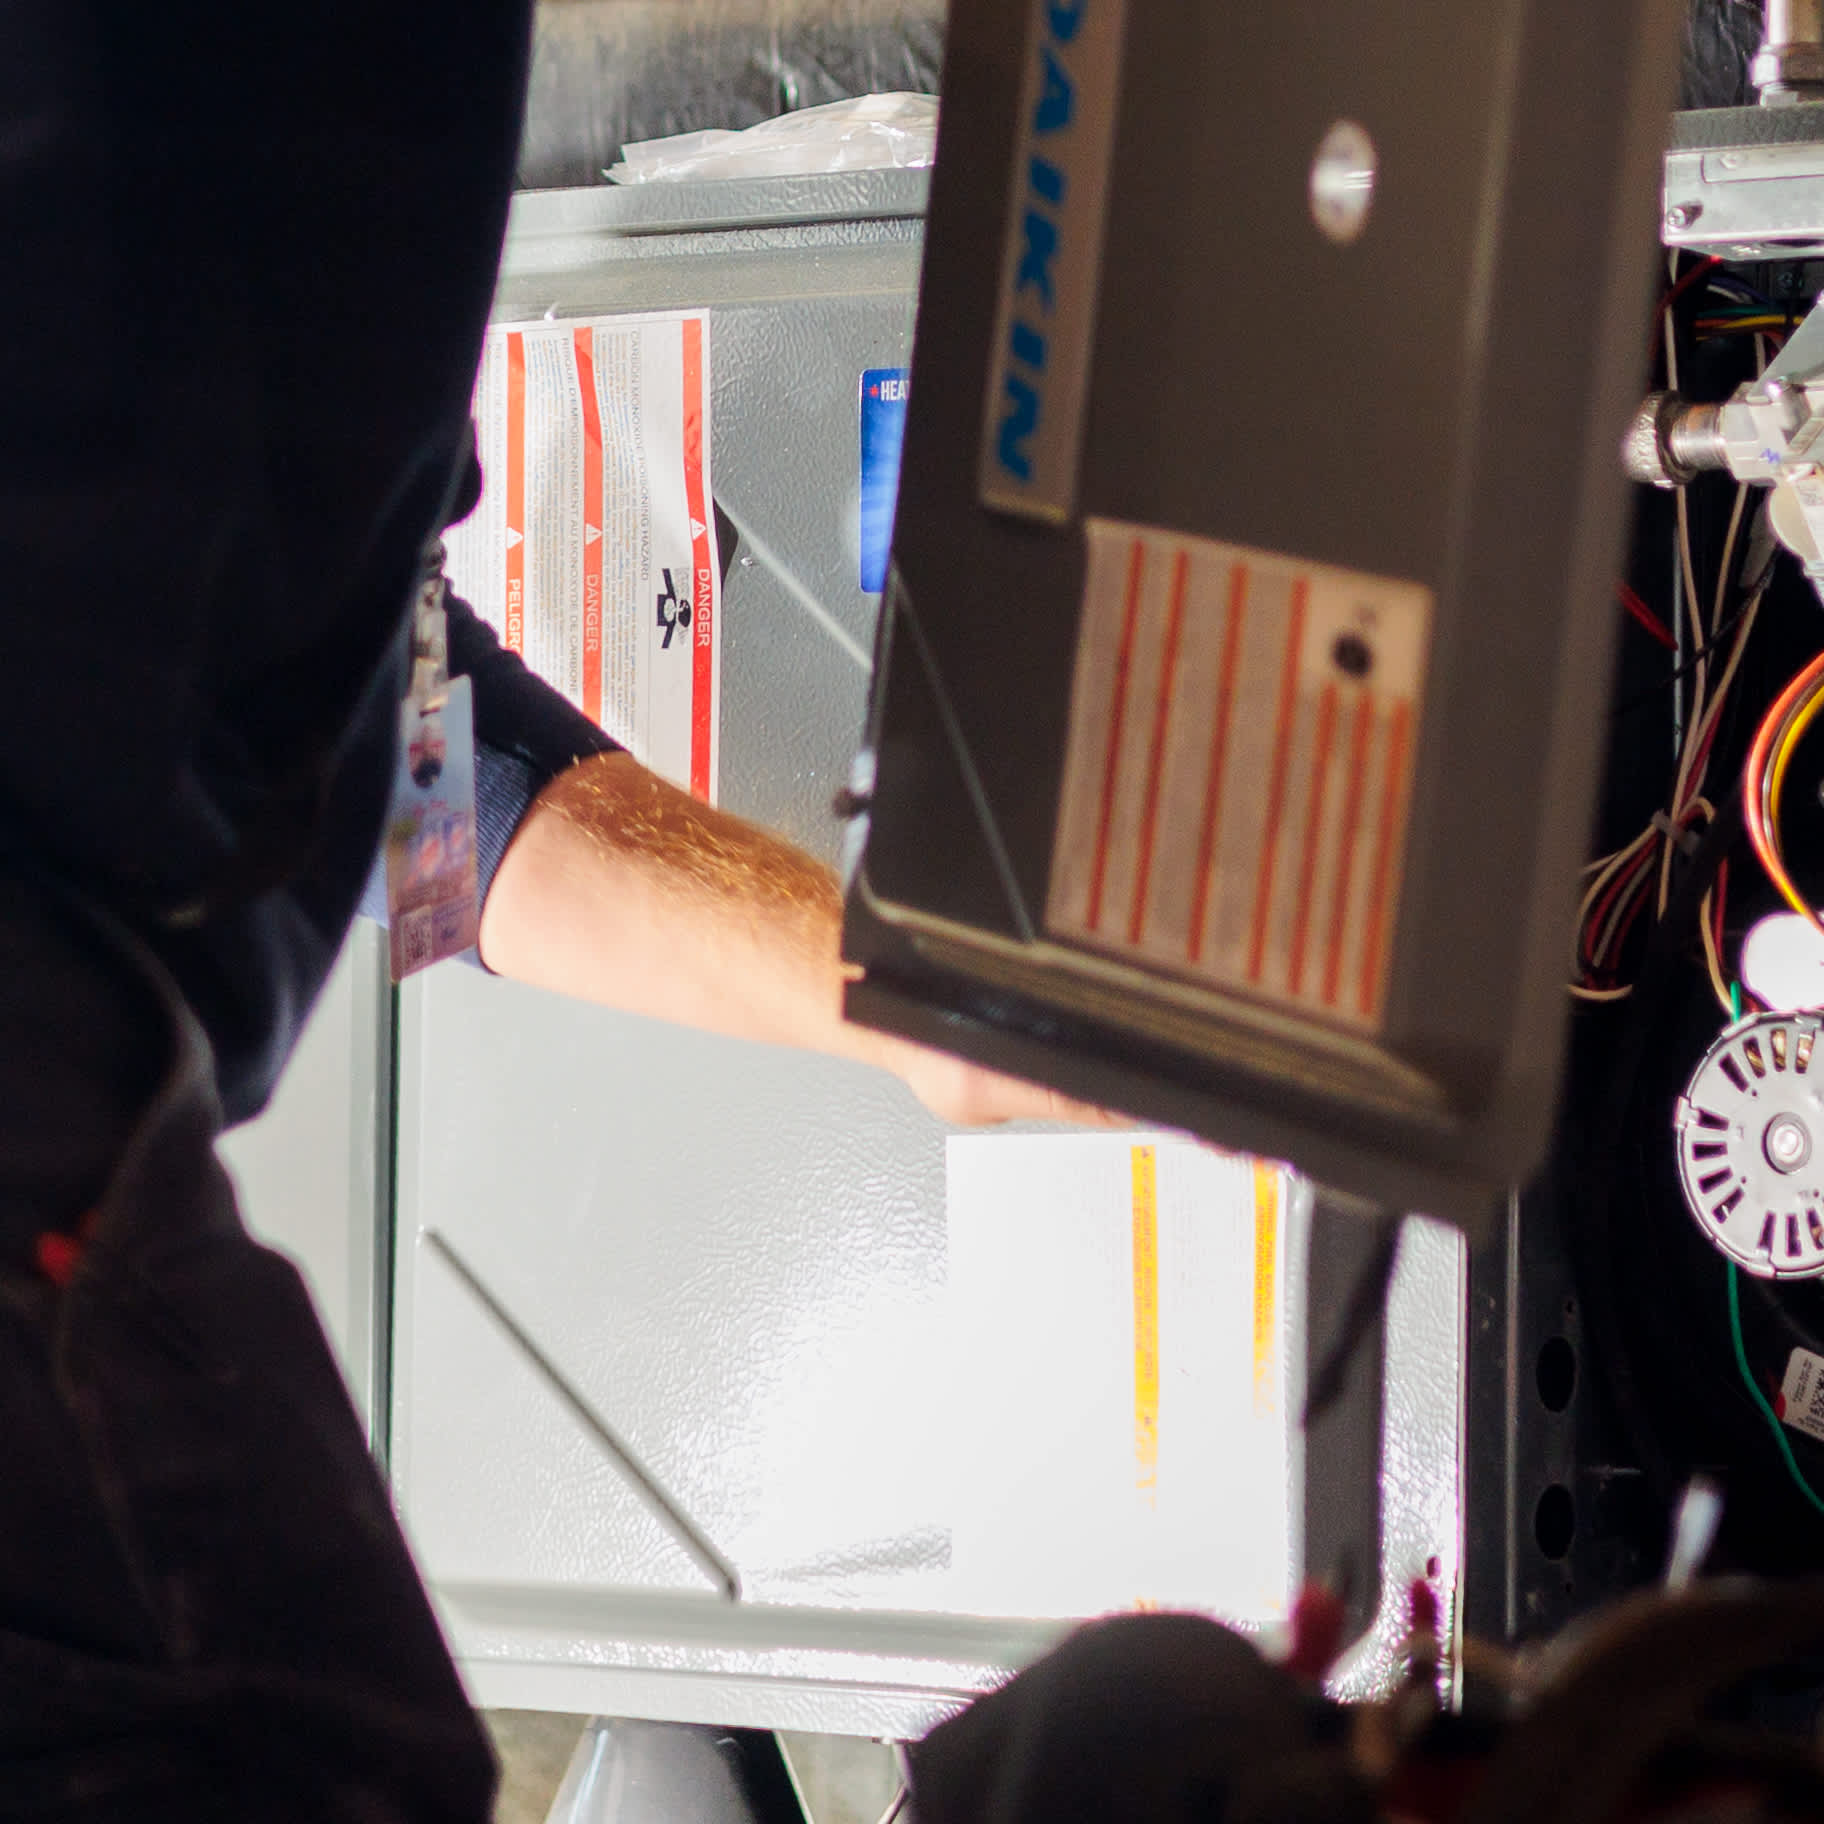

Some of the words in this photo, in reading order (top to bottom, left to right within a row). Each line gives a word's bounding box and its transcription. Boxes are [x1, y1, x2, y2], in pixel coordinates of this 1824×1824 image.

[880, 379, 909, 402] HEA
[641, 530, 649, 581] HAZARD
[586, 574, 599, 652] DANGER
[697, 569, 710, 647] DANGER
